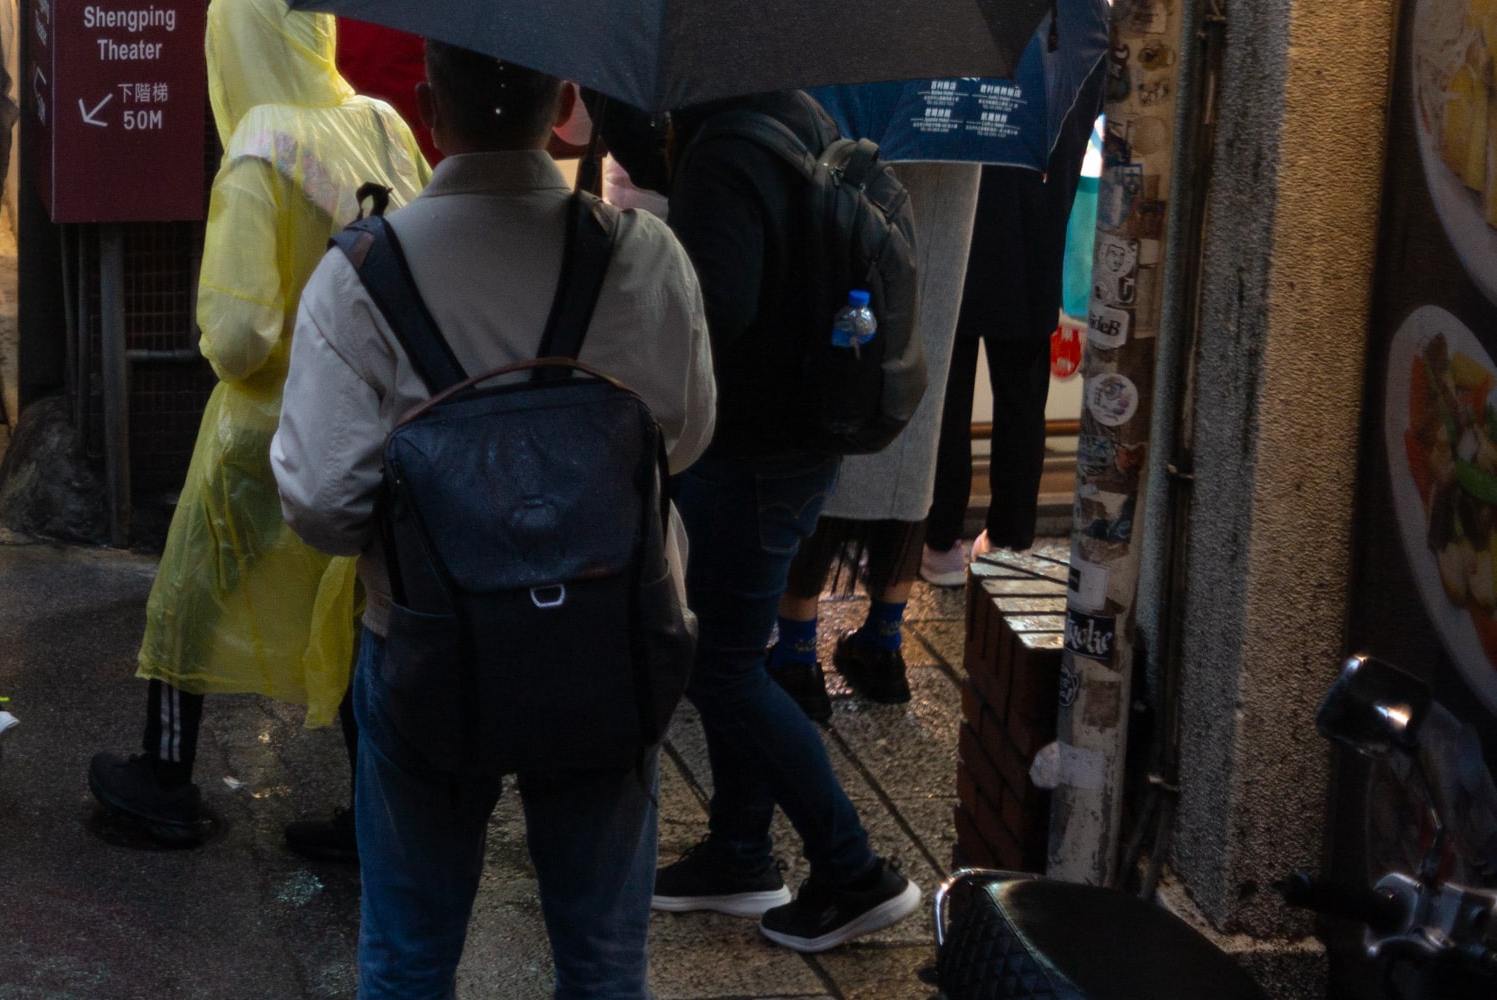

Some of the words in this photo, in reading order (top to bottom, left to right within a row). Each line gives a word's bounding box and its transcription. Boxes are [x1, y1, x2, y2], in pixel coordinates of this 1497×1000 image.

[83, 4, 176, 33] Shengping
[97, 38, 163, 61] Theater
[117, 82, 169, 104] 下階梯
[122, 109, 163, 131] 50M
